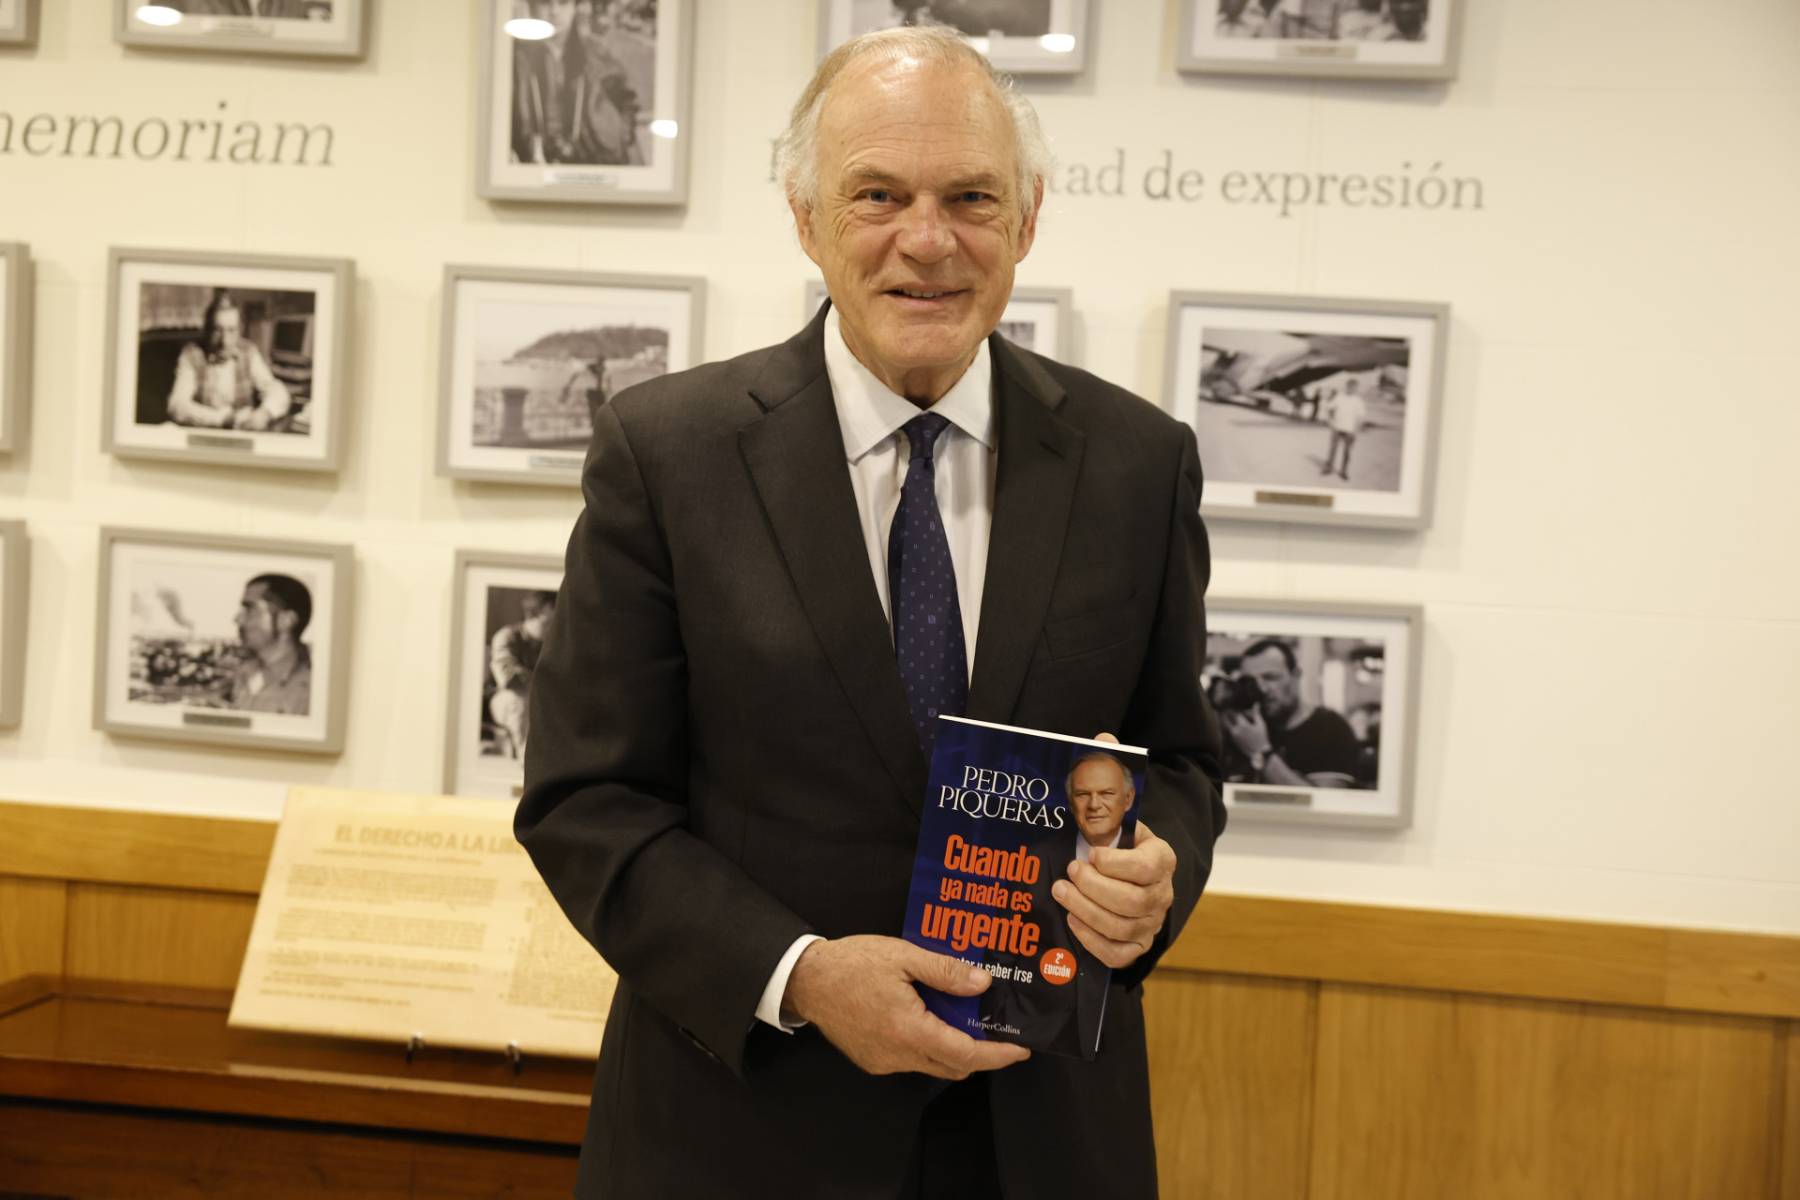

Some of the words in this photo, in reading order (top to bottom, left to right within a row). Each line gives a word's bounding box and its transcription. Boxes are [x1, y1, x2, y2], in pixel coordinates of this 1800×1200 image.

[0, 101, 334, 166] emoriam
[1142, 149, 1205, 202] de
[1220, 160, 1486, 217] expresión
[961, 765, 1050, 802] PEDRO
[938, 785, 1066, 830] PIQUERAS
[358, 826, 444, 849] DERECHO
[943, 833, 1041, 885] Cuando
[940, 877, 963, 902] ya
[964, 882, 1008, 910] nada
[1010, 890, 1033, 913] es
[920, 903, 1041, 957] urgente
[985, 963, 1012, 980] saber
[1013, 966, 1033, 984] irse
[1044, 963, 1072, 978] EDICIÓN
[967, 1017, 1021, 1035] HarperCollins
